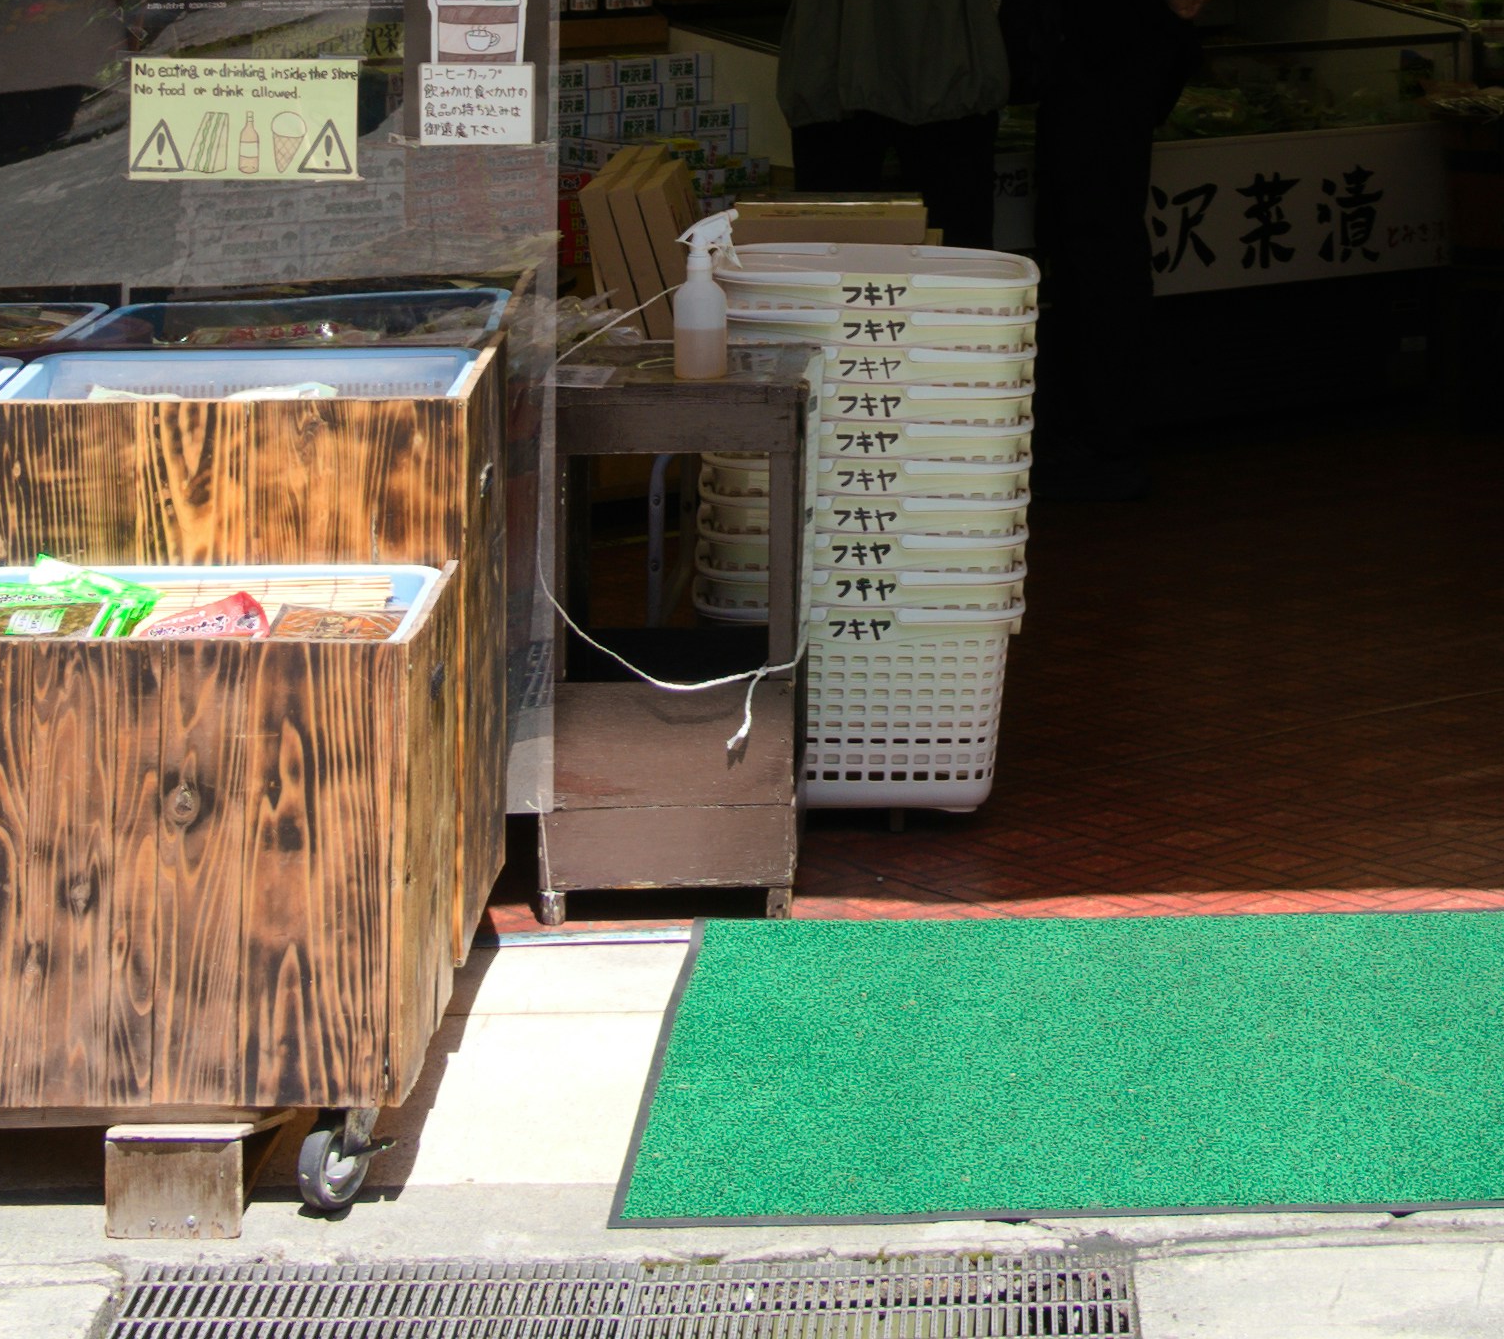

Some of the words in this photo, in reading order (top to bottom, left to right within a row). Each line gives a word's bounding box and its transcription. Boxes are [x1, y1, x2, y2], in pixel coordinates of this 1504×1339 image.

[135, 62, 154, 77] No
[158, 63, 199, 81] eating
[203, 67, 218, 77] or
[219, 62, 267, 81] drinking
[271, 66, 307, 80] inside
[309, 66, 331, 80] the
[424, 66, 503, 81] コーヒーカップ
[135, 83, 154, 96] No
[158, 82, 186, 97] food
[194, 88, 208, 97] or
[211, 84, 244, 98] drink
[1151, 164, 1384, 273] 沢菜漬
[842, 283, 908, 308] フキヤ
[843, 320, 906, 343] フキヤ
[839, 356, 902, 380] フキヤ
[838, 393, 901, 418] フキヤ
[836, 430, 899, 453] フキヤ
[837, 467, 898, 491] フキヤ
[833, 506, 898, 531] フキヤ
[832, 542, 892, 566] フキヤ
[835, 577, 897, 602] フキヤ
[828, 618, 892, 641] フキヤ
